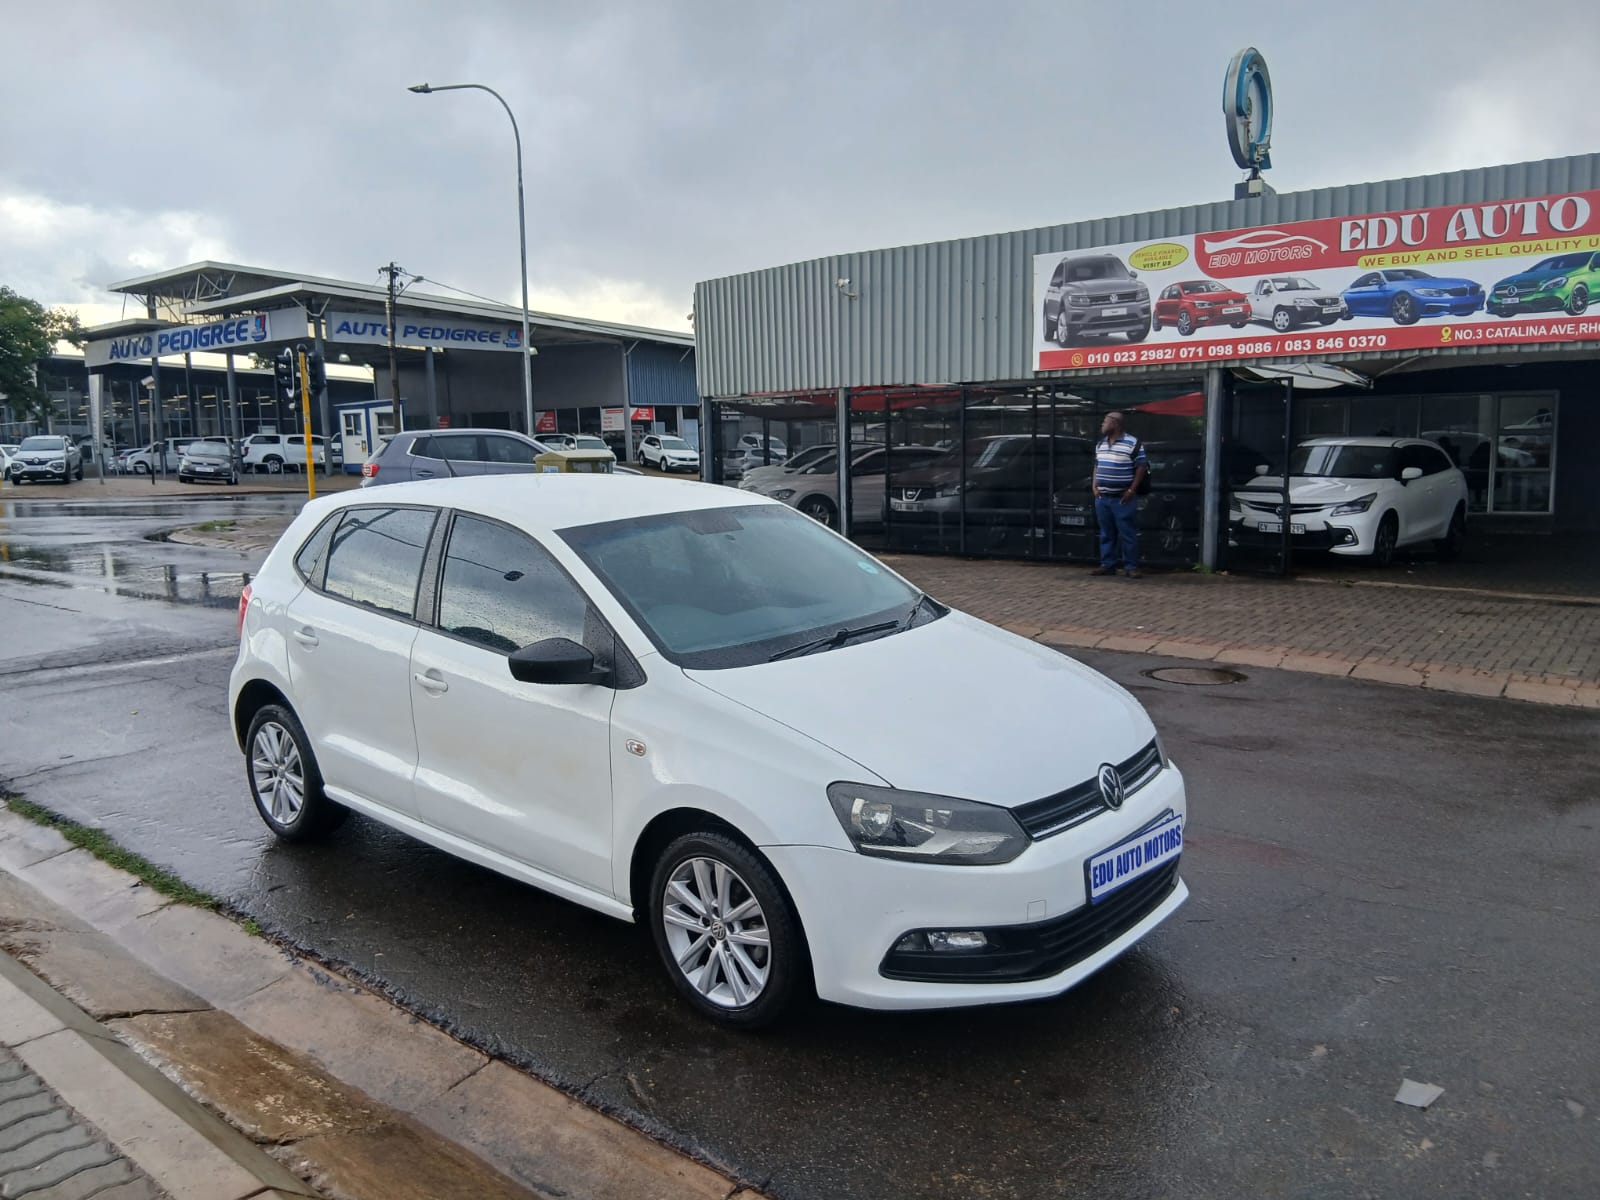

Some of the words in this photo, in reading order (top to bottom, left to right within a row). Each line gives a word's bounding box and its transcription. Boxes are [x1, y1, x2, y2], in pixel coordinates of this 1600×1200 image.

[1340, 212, 1430, 252] EDU
[1444, 196, 1591, 243] AUTO
[1142, 261, 1161, 269] VISIT
[1208, 252, 1242, 268] EDU
[1244, 244, 1313, 264] MOTORS
[1364, 256, 1385, 267] WE
[1391, 254, 1421, 265] BUY
[1426, 250, 1458, 262] AND
[1464, 247, 1503, 258] SELL
[1509, 239, 1582, 255] QUALITY
[109, 335, 153, 360] AUTO
[157, 319, 249, 354] PEDIGREE
[402, 324, 502, 344] PEDIGREE
[1454, 328, 1483, 341] NO.3
[1485, 324, 1548, 339] CATALINA
[1087, 353, 1110, 364] 010
[1113, 351, 1137, 363] 023
[1179, 346, 1203, 358] 071
[1207, 344, 1233, 356] 098
[1237, 341, 1272, 354] 9086
[1284, 339, 1312, 351] 083
[1315, 337, 1344, 350] 846
[1348, 334, 1387, 348] 0370
[1092, 858, 1114, 889] EDU
[1116, 844, 1142, 878] AUTO
[1144, 824, 1181, 864] MOTORS
